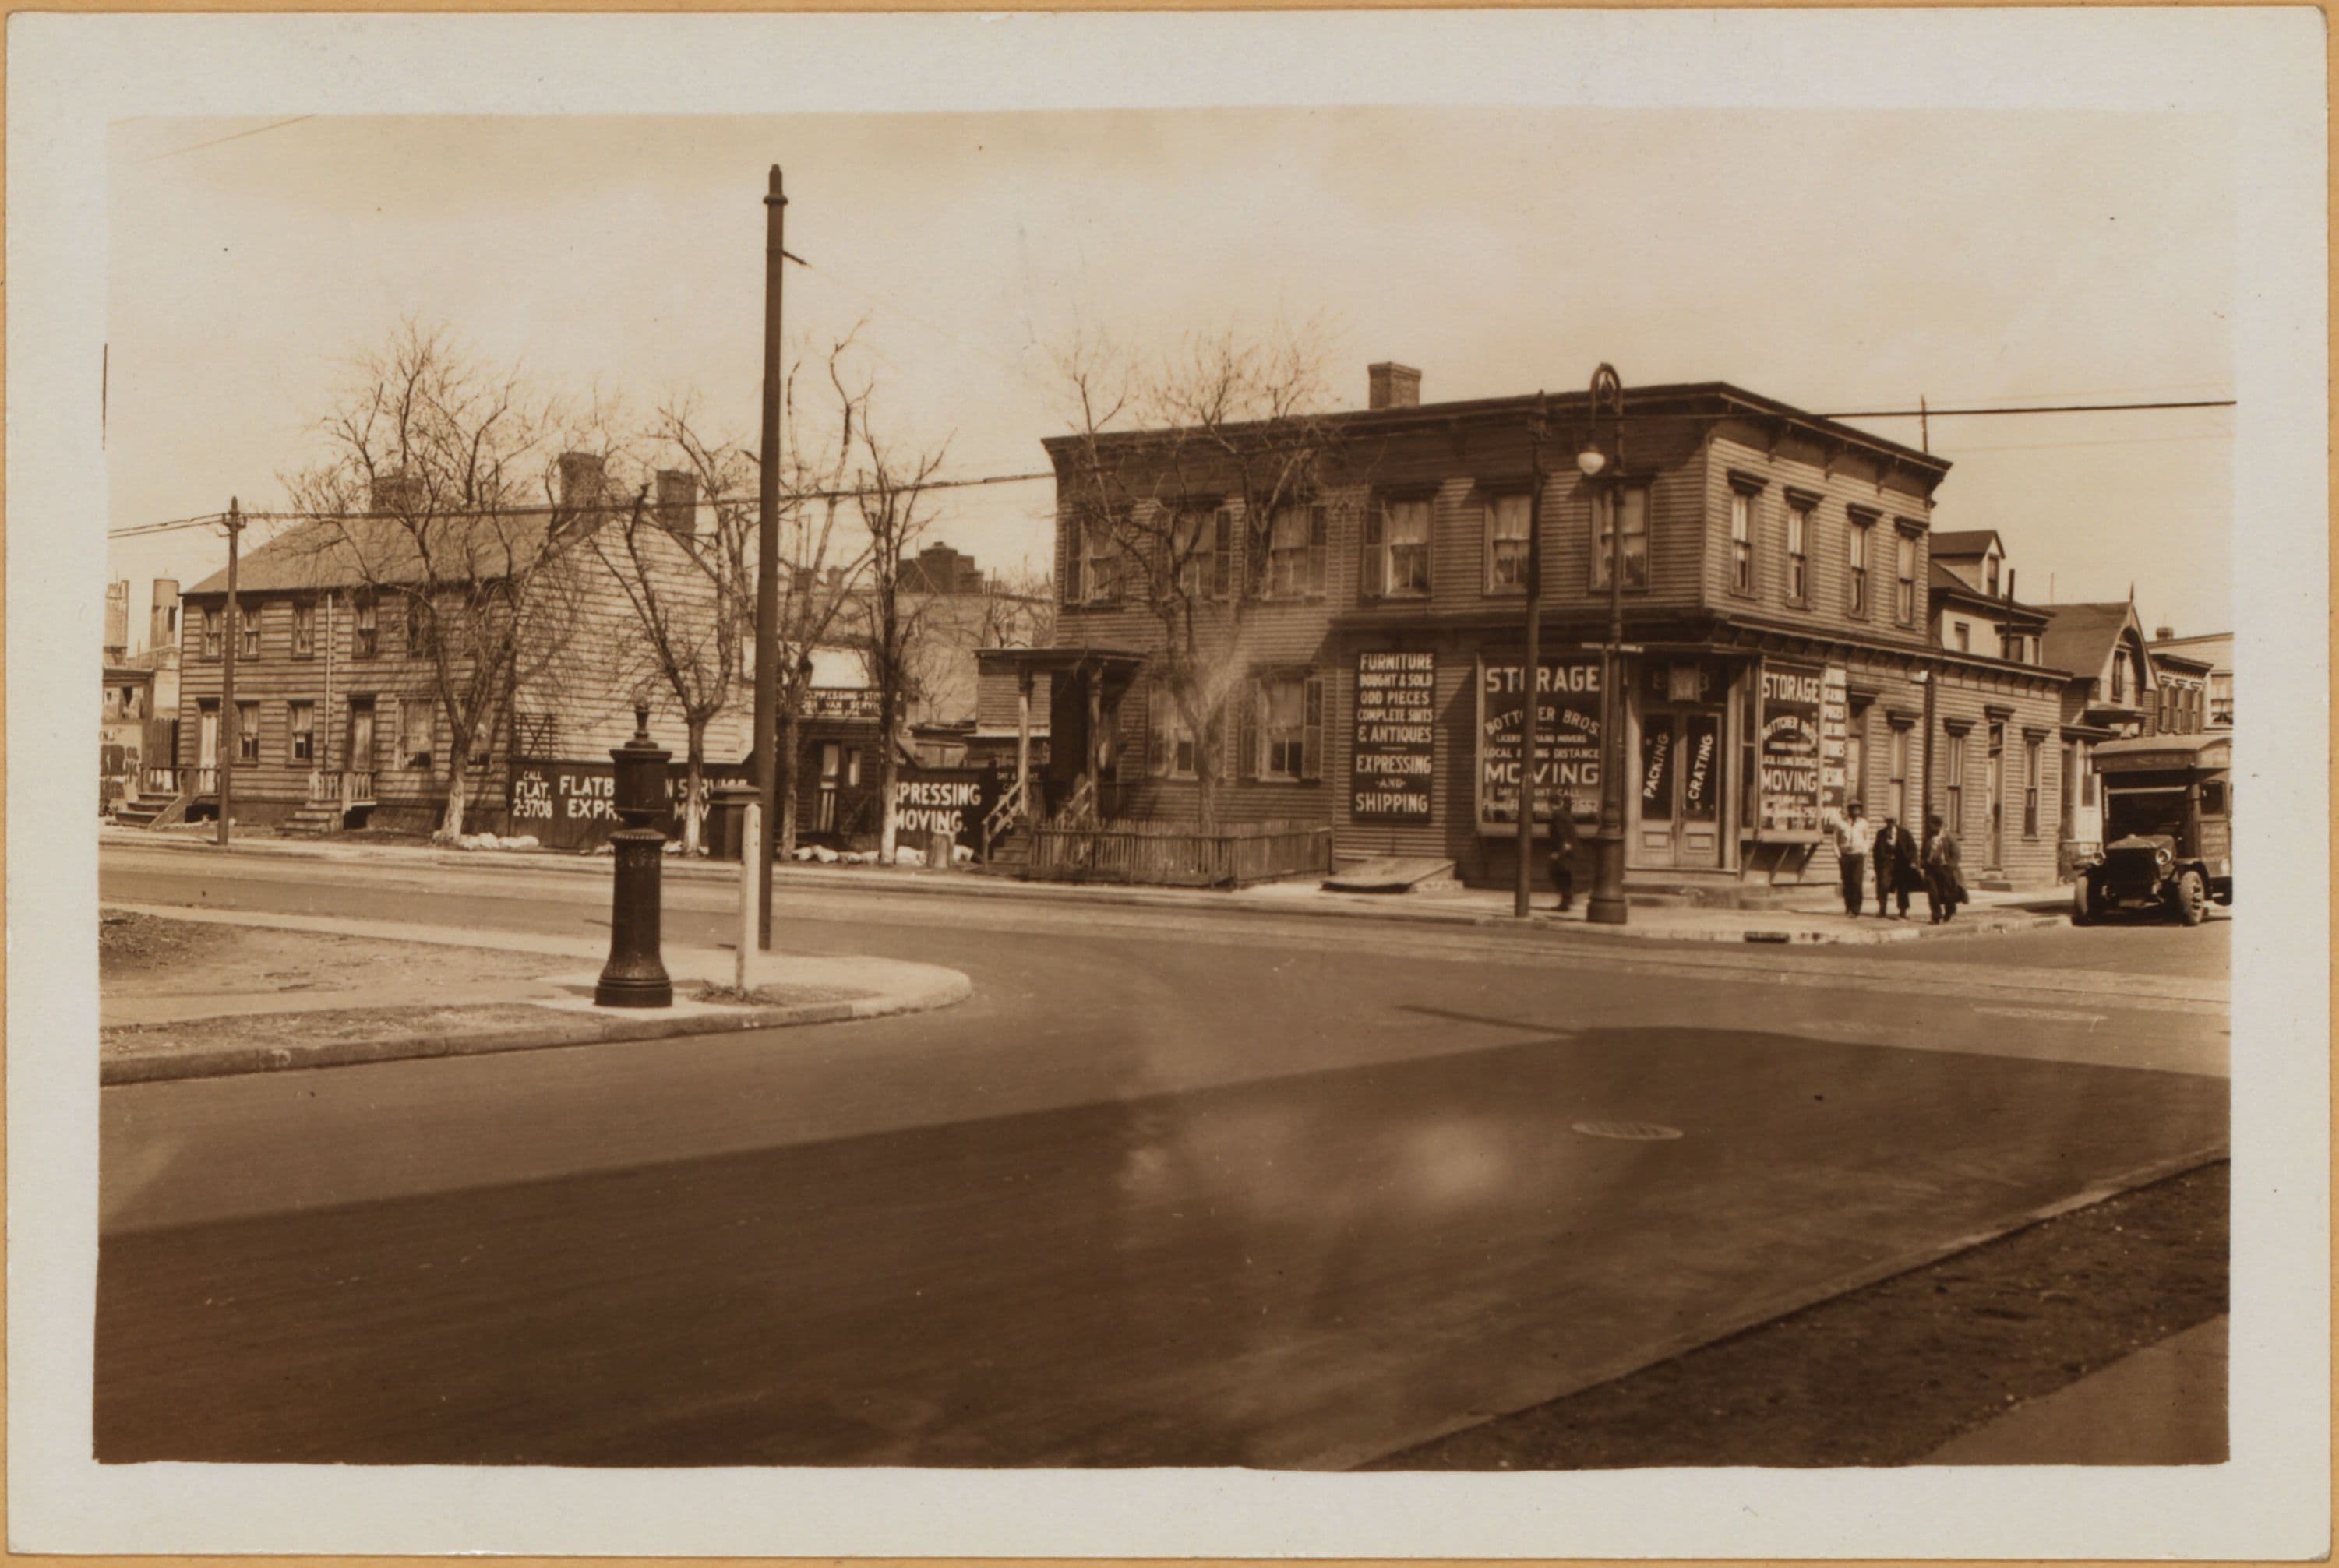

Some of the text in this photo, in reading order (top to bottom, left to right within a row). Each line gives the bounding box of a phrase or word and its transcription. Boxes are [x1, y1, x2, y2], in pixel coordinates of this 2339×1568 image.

[1360, 653, 1433, 670] FURNITURE
[1359, 673, 1433, 687] BOUGHT & SOLD
[1486, 666, 1600, 692] STRAGE
[1762, 671, 1820, 703] STORAGE
[1360, 691, 1429, 704] ODD PIECES
[1357, 709, 1404, 721] COMPLETE
[1485, 706, 1555, 735] BOTTER
[1370, 726, 1431, 742] ANTIQUES
[1356, 754, 1431, 773] EXPRESSING
[1483, 748, 1512, 758] LOCAL
[1554, 749, 1599, 759] DISTANCE
[523, 770, 542, 780] CALL
[1484, 763, 1599, 784] MOVING
[1643, 733, 1669, 798] PACKING
[1688, 733, 1713, 799] CRATING
[559, 774, 615, 796] FLATB
[1762, 769, 1817, 792] MOVING
[895, 782, 981, 805] PRESSING
[1356, 792, 1427, 812] SHIPPING
[513, 798, 552, 818] 2-3708
[567, 798, 623, 820] EXPR
